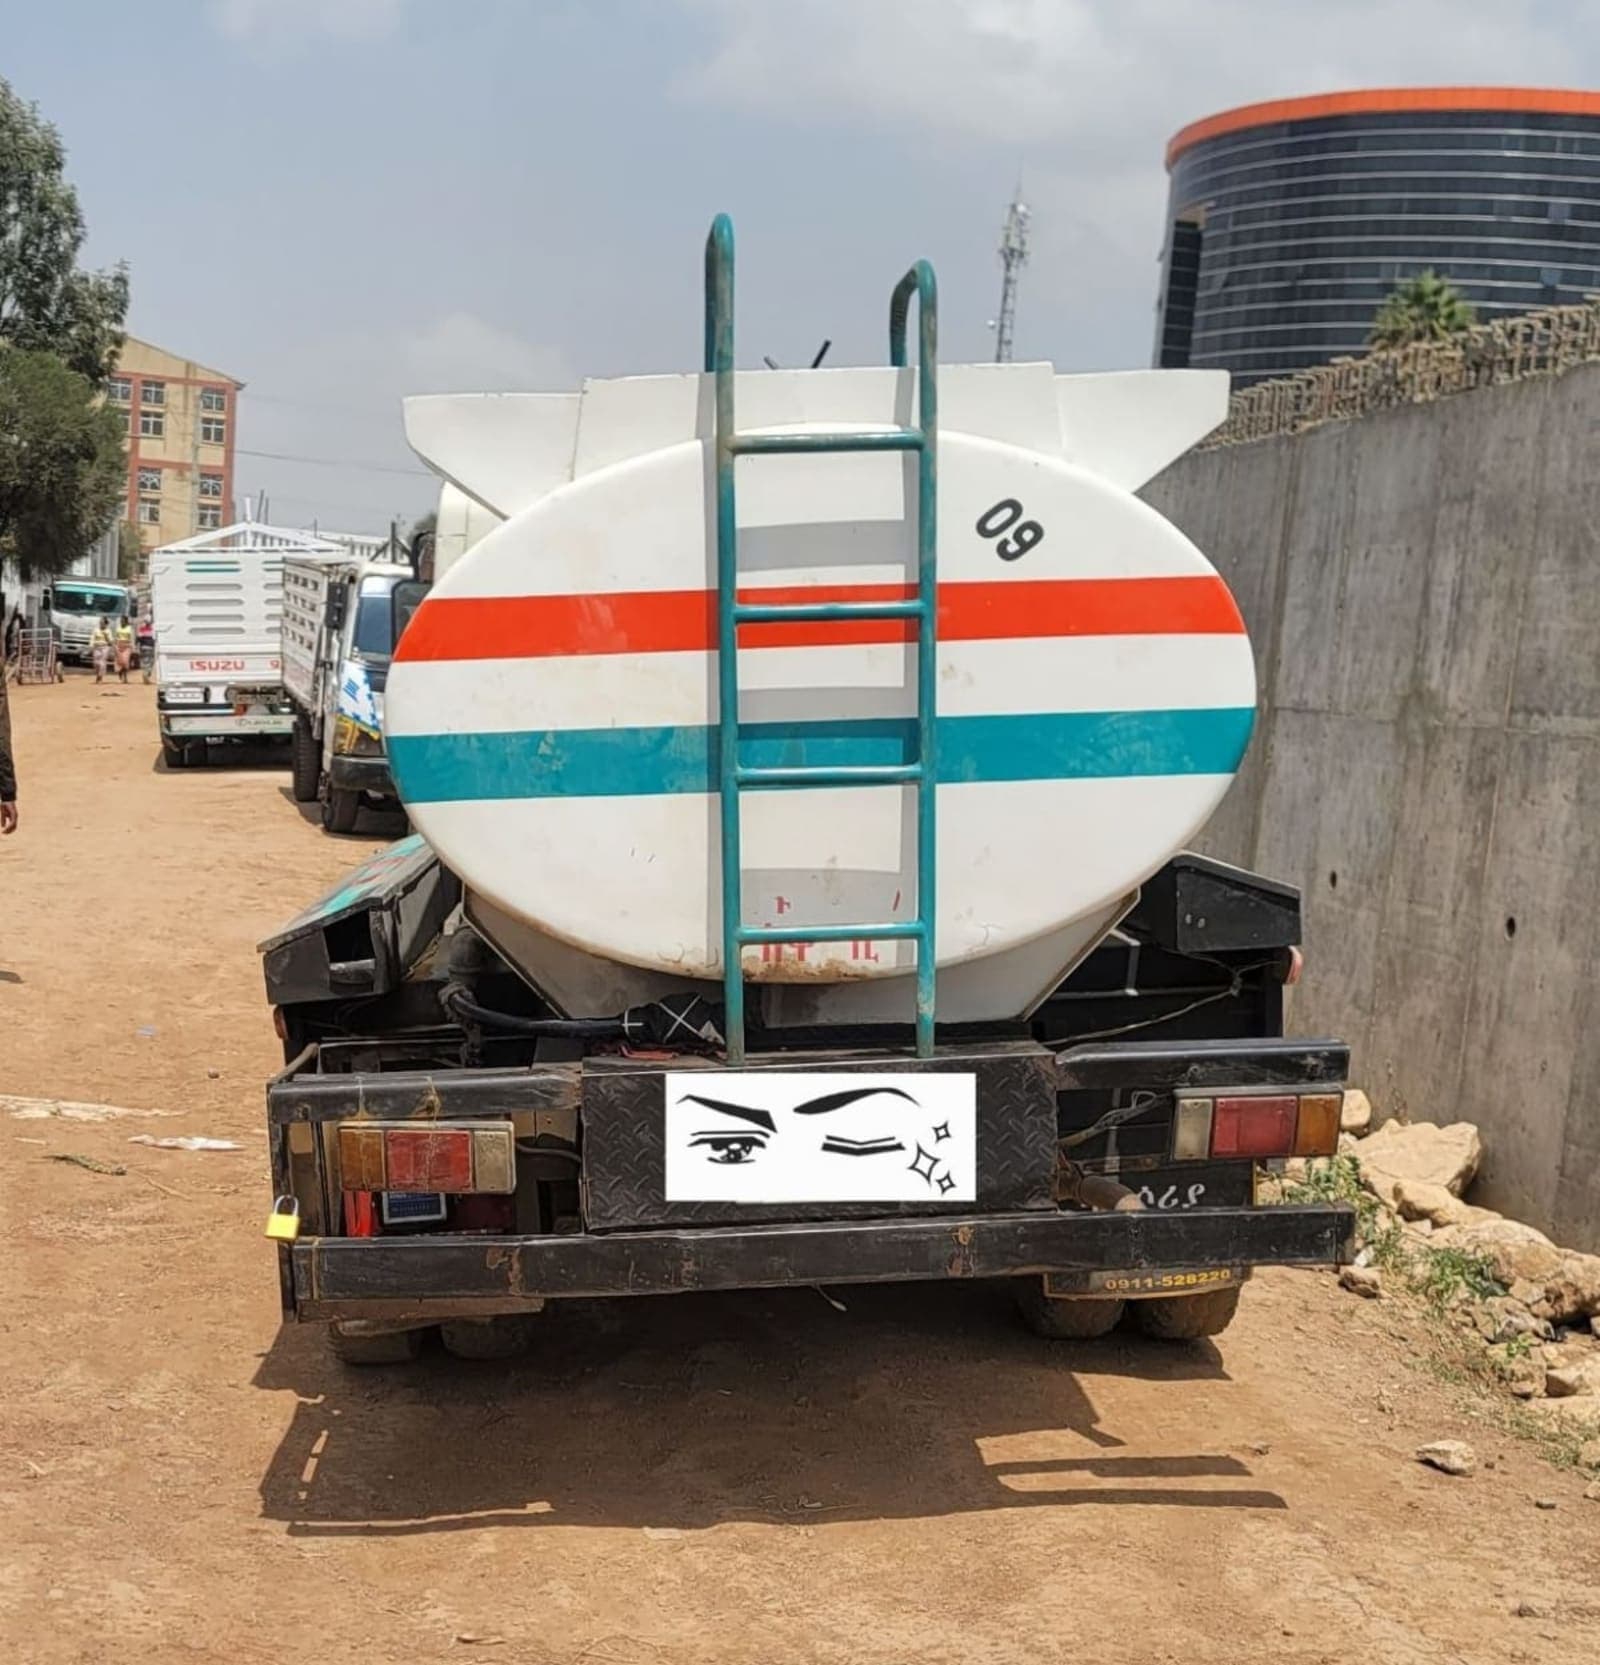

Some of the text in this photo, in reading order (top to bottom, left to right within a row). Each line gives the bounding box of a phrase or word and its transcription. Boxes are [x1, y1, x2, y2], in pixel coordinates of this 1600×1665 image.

[976, 498, 1044, 562] 09
[189, 660, 245, 671] ISUZU
[1105, 1268, 1232, 1290] 0911-528220
